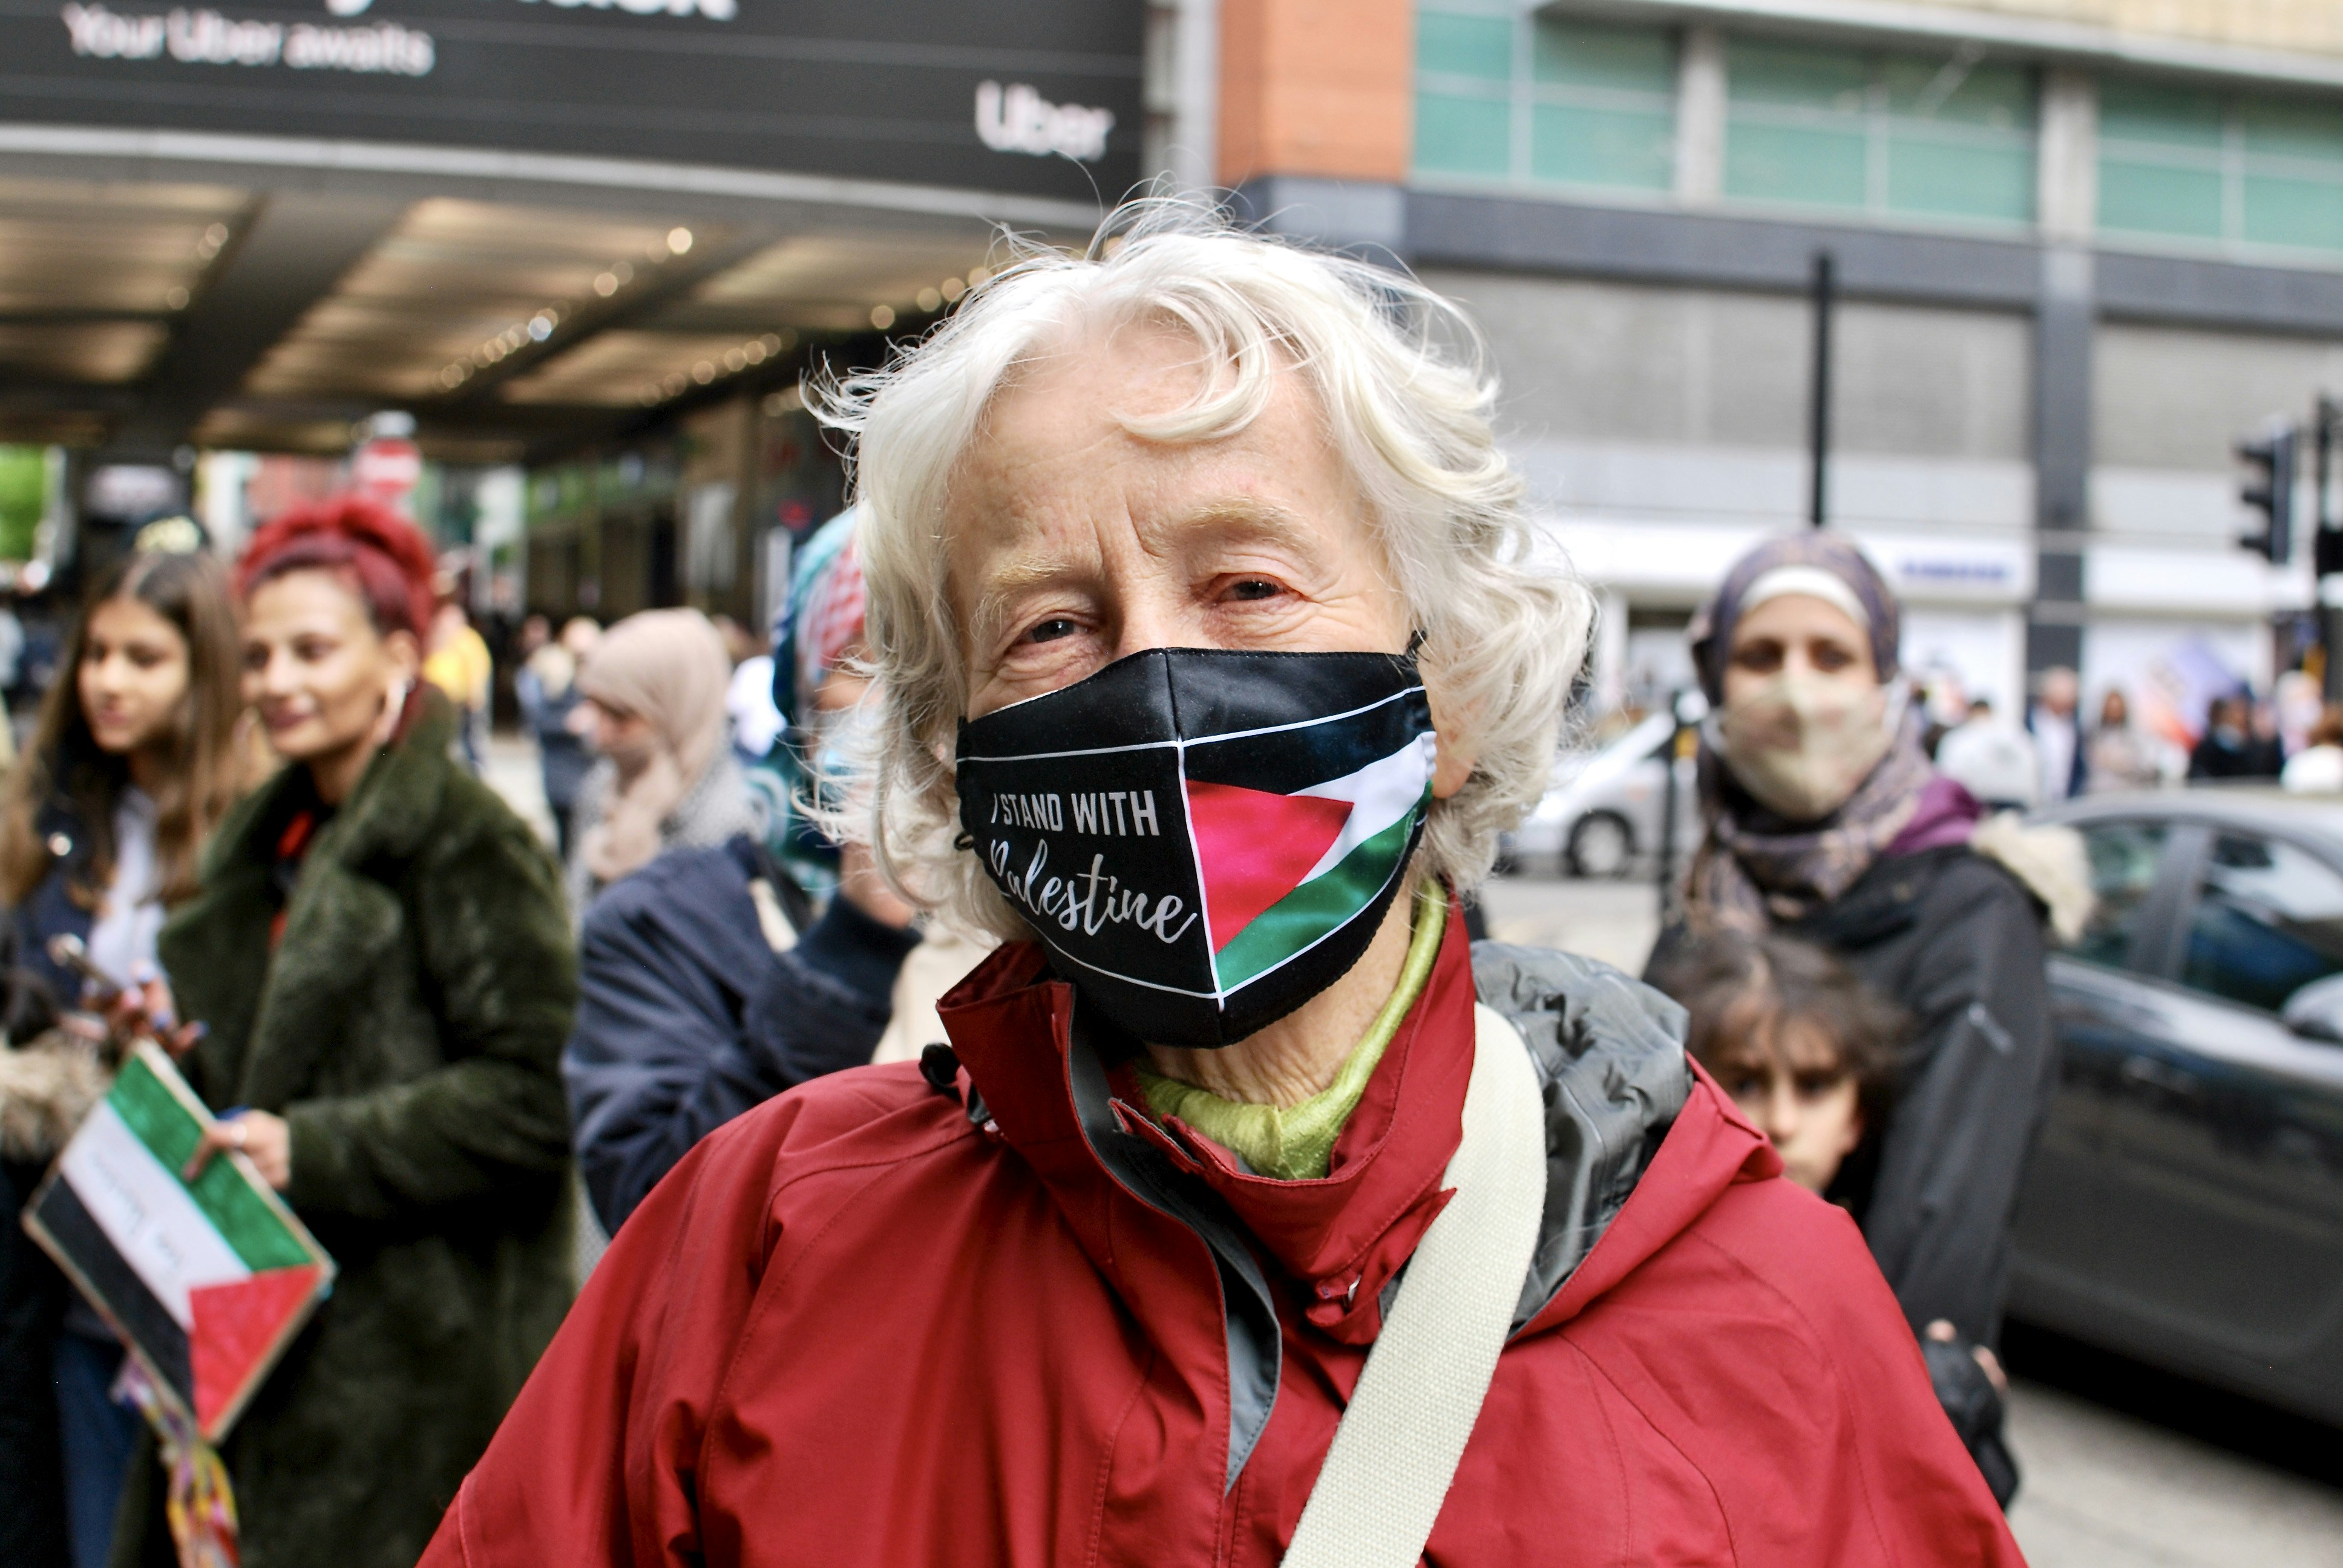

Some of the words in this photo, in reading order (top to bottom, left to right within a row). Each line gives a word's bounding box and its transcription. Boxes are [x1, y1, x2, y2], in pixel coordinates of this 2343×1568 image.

[63, 4, 165, 58] Your
[168, 8, 281, 65] Uber
[284, 22, 434, 76] awaits
[975, 80, 1115, 162] Uber
[991, 793, 998, 824] I
[1000, 793, 1064, 832] STAND
[1070, 789, 1161, 836] WITH
[990, 838, 1198, 944] Palestine
